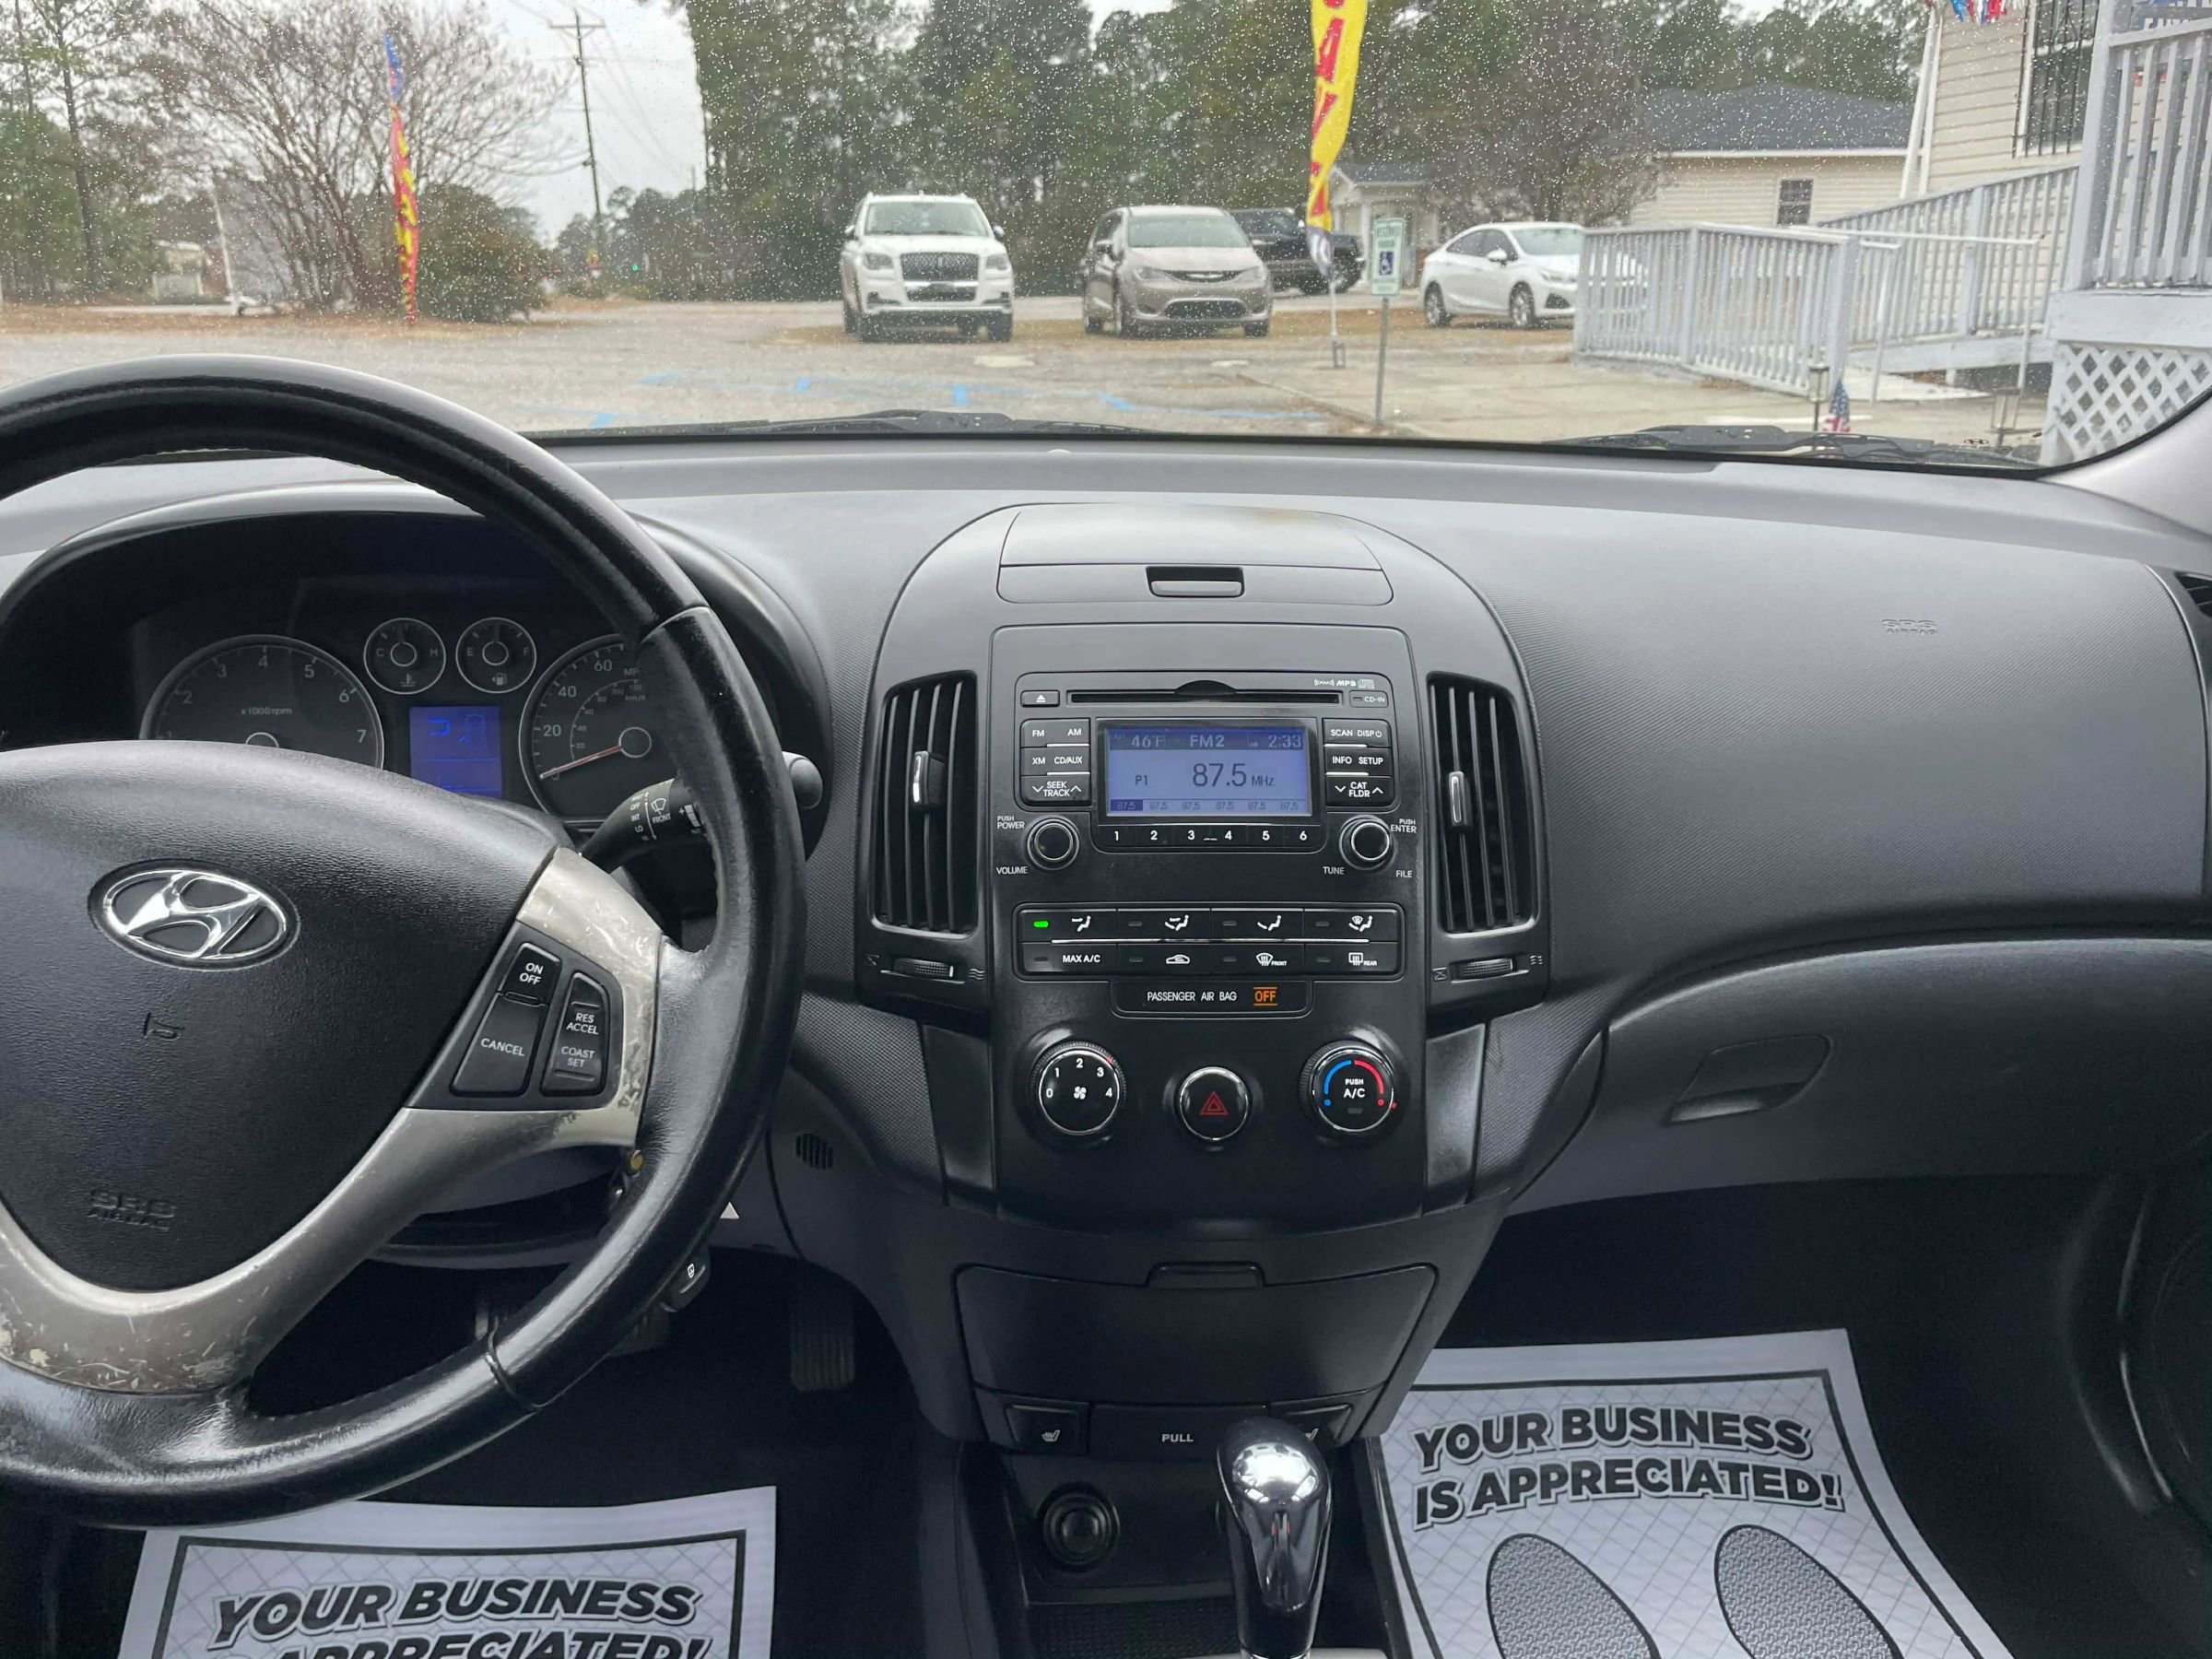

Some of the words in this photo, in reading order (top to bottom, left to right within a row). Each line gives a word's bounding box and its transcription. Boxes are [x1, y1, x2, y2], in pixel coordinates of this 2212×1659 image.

[258, 655, 268, 668] 4
[594, 659, 613, 672] 60
[217, 665, 228, 677] 3
[304, 665, 314, 678] 5
[338, 688, 349, 703] 6
[558, 686, 577, 698] 40
[182, 692, 193, 704] 2
[543, 724, 561, 736] 20
[1032, 729, 1045, 737] FM
[1067, 728, 1082, 736] AM
[1357, 729, 1374, 737] DISP
[357, 729, 367, 743] 7
[1190, 735, 1225, 747] FM2
[1267, 734, 1301, 747] 2:33
[1032, 757, 1046, 765] XM
[1053, 756, 1083, 764] CD/AUX
[1332, 756, 1352, 764] INFO
[1358, 757, 1384, 765] SETUP
[1135, 774, 1148, 786] P1
[1193, 762, 1247, 787] 87.5
[1252, 774, 1276, 786] MHz
[1046, 781, 1067, 789] SEEK
[1042, 788, 1070, 797] TRACK
[1348, 789, 1371, 798] FLDR
[651, 813, 672, 824] FRONT
[996, 821, 1026, 830] POWER
[1390, 824, 1417, 833] ENTER
[1114, 830, 1119, 841] 1
[1150, 830, 1158, 840] 2
[1187, 830, 1195, 841] 3
[1224, 830, 1232, 840] 4
[1262, 830, 1270, 841] 5
[1300, 830, 1308, 841] 6
[996, 866, 1029, 875] VOLUME
[1323, 866, 1345, 875] TUNE
[1395, 870, 1413, 878] FILE
[1062, 954, 1082, 963] MAX
[1083, 954, 1100, 963] A/C
[525, 962, 544, 974] ON
[519, 973, 542, 985] OFF
[1147, 991, 1195, 1002] PASSENGER
[1201, 991, 1215, 1002] AIR
[1219, 991, 1238, 1002] BAG
[1254, 991, 1277, 1003] OFF
[575, 1012, 594, 1023] RES
[566, 1022, 599, 1035] ACCEL
[480, 1038, 525, 1057] CANCEL
[561, 1046, 596, 1059] COAST
[568, 1057, 586, 1068] SET
[1076, 1058, 1083, 1068] 2
[1054, 1067, 1059, 1077] 1
[1097, 1067, 1104, 1077] 3
[1046, 1088, 1053, 1098] 0
[1105, 1088, 1113, 1098] 4
[1343, 1088, 1365, 1099] A/C
[1161, 1433, 1194, 1442] PULL
[1413, 1410, 1552, 1469] YOUR
[1560, 1406, 1813, 1456] BUSINESS
[1415, 1479, 1464, 1525] IS
[1473, 1457, 1842, 1512] APPRECIATED!
[212, 1583, 394, 1645] YOUR
[396, 1577, 699, 1622] BUSINESS
[278, 1630, 710, 1659] RECIATED!
